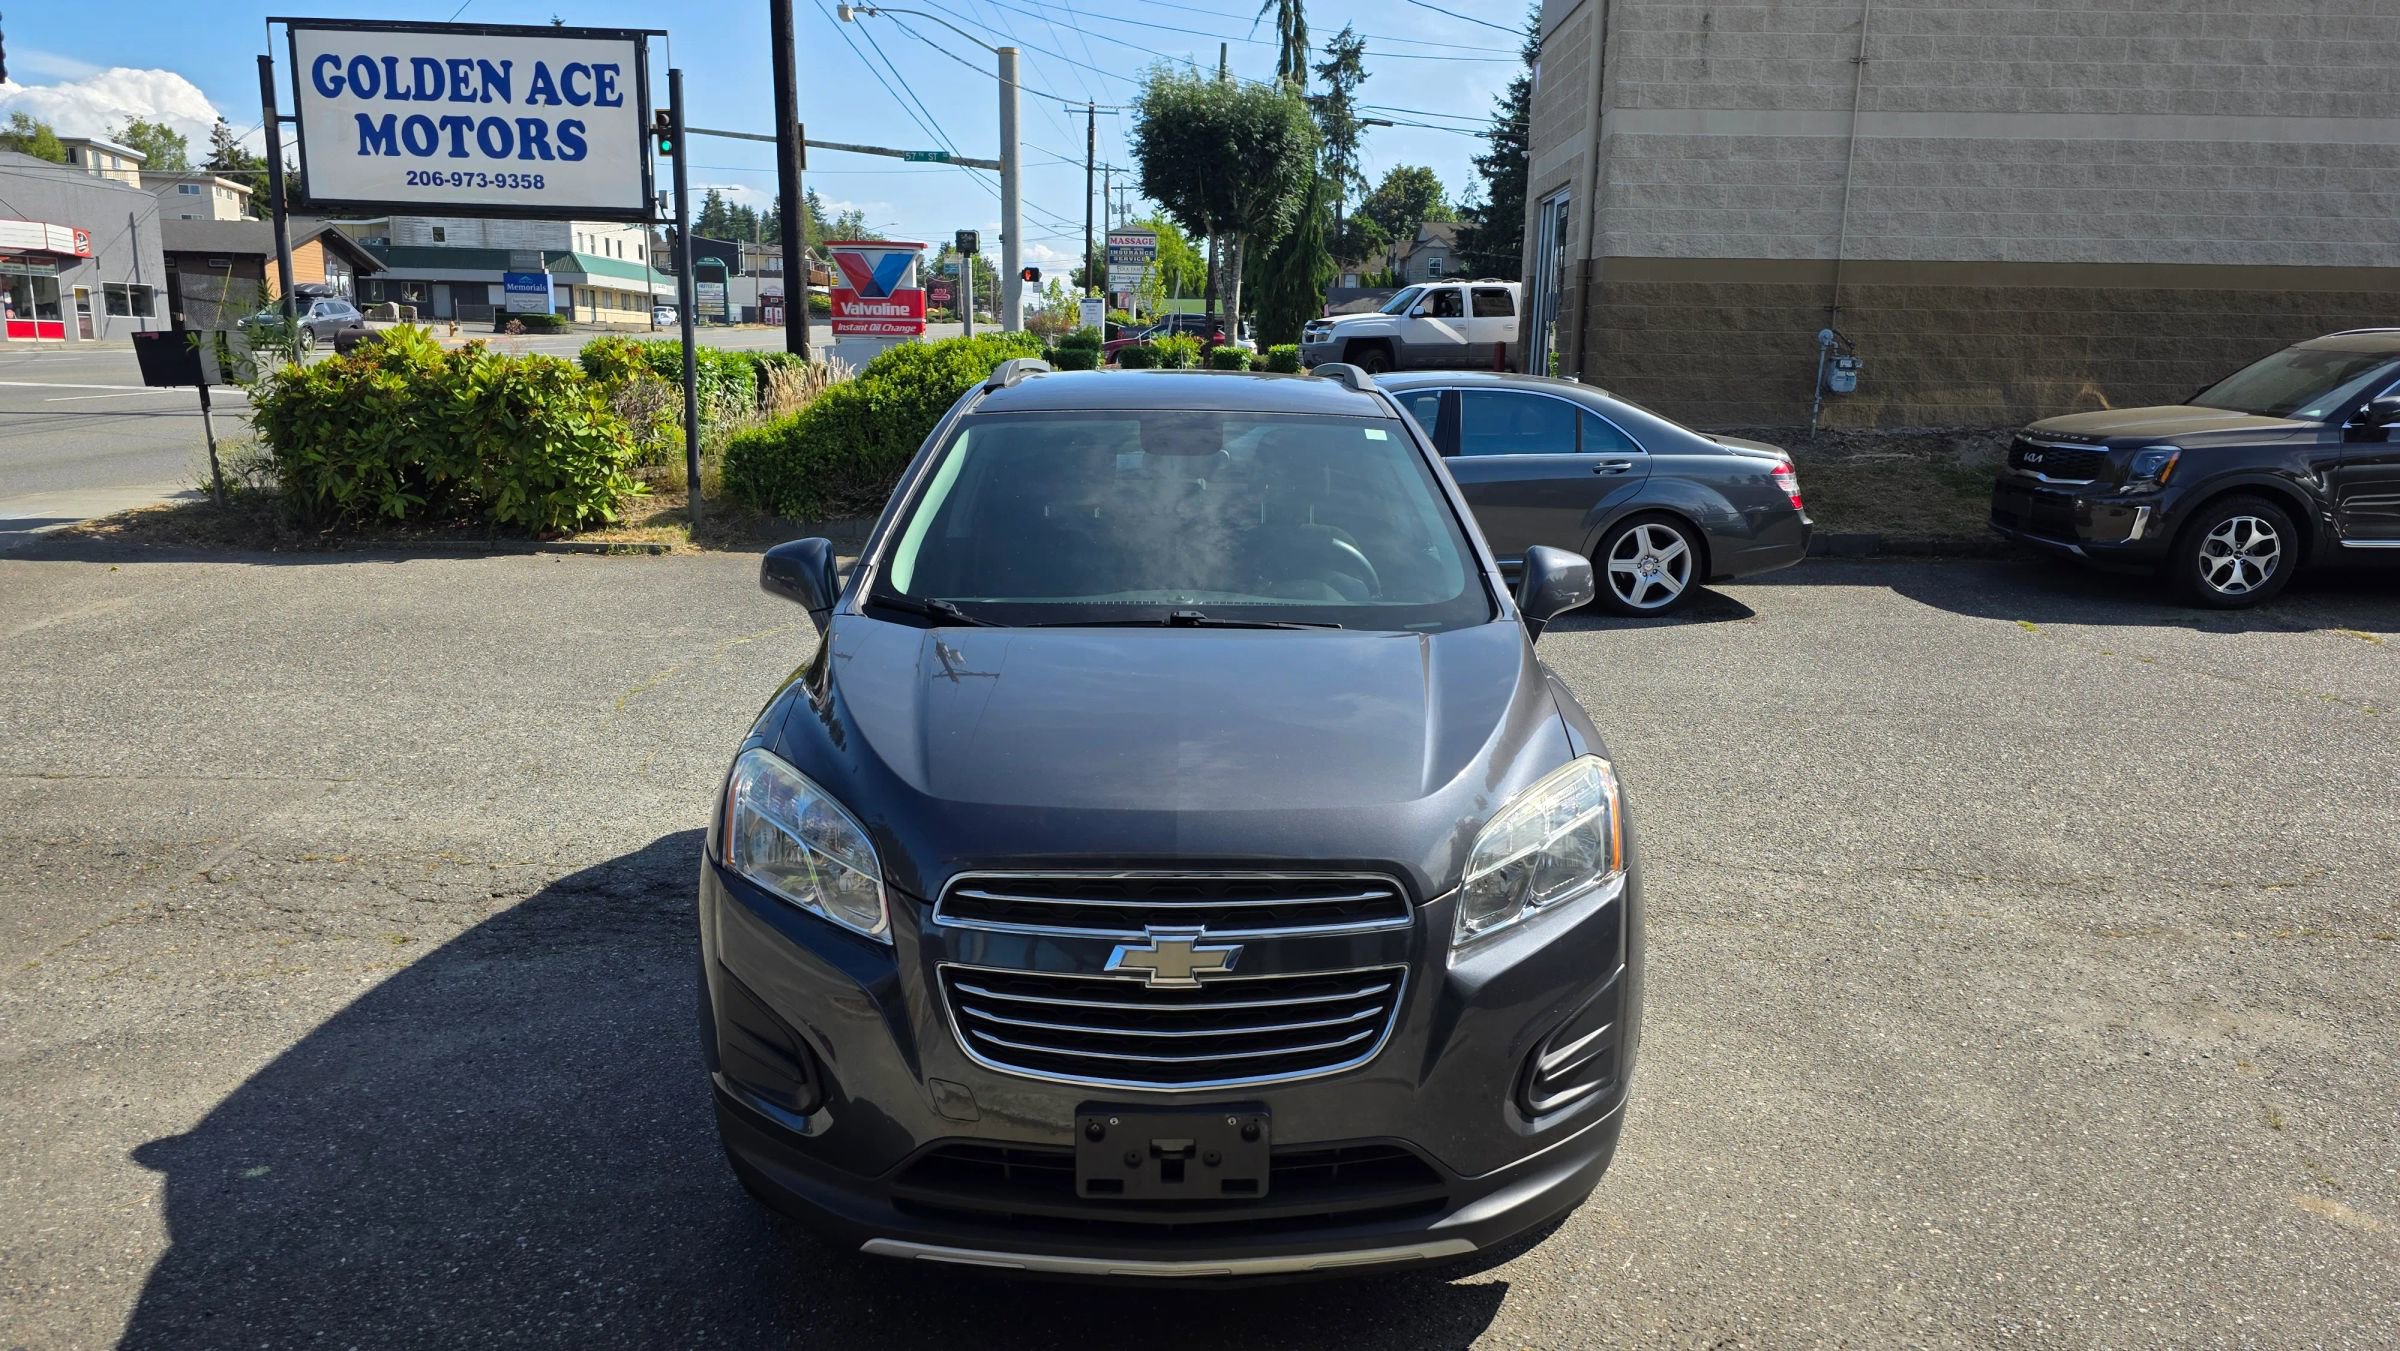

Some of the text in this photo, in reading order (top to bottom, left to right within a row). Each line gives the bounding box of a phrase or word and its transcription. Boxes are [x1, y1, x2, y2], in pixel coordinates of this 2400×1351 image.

[311, 53, 624, 108] GOLDEN ACE
[354, 112, 588, 162] MOTORS
[928, 152, 938, 161] ST
[406, 170, 545, 190] 206-973-9358
[1110, 237, 1154, 246] MASSAGE
[506, 283, 547, 292] Memorials
[840, 302, 910, 316] Valvoline
[837, 322, 917, 334] Instant Oil Change
